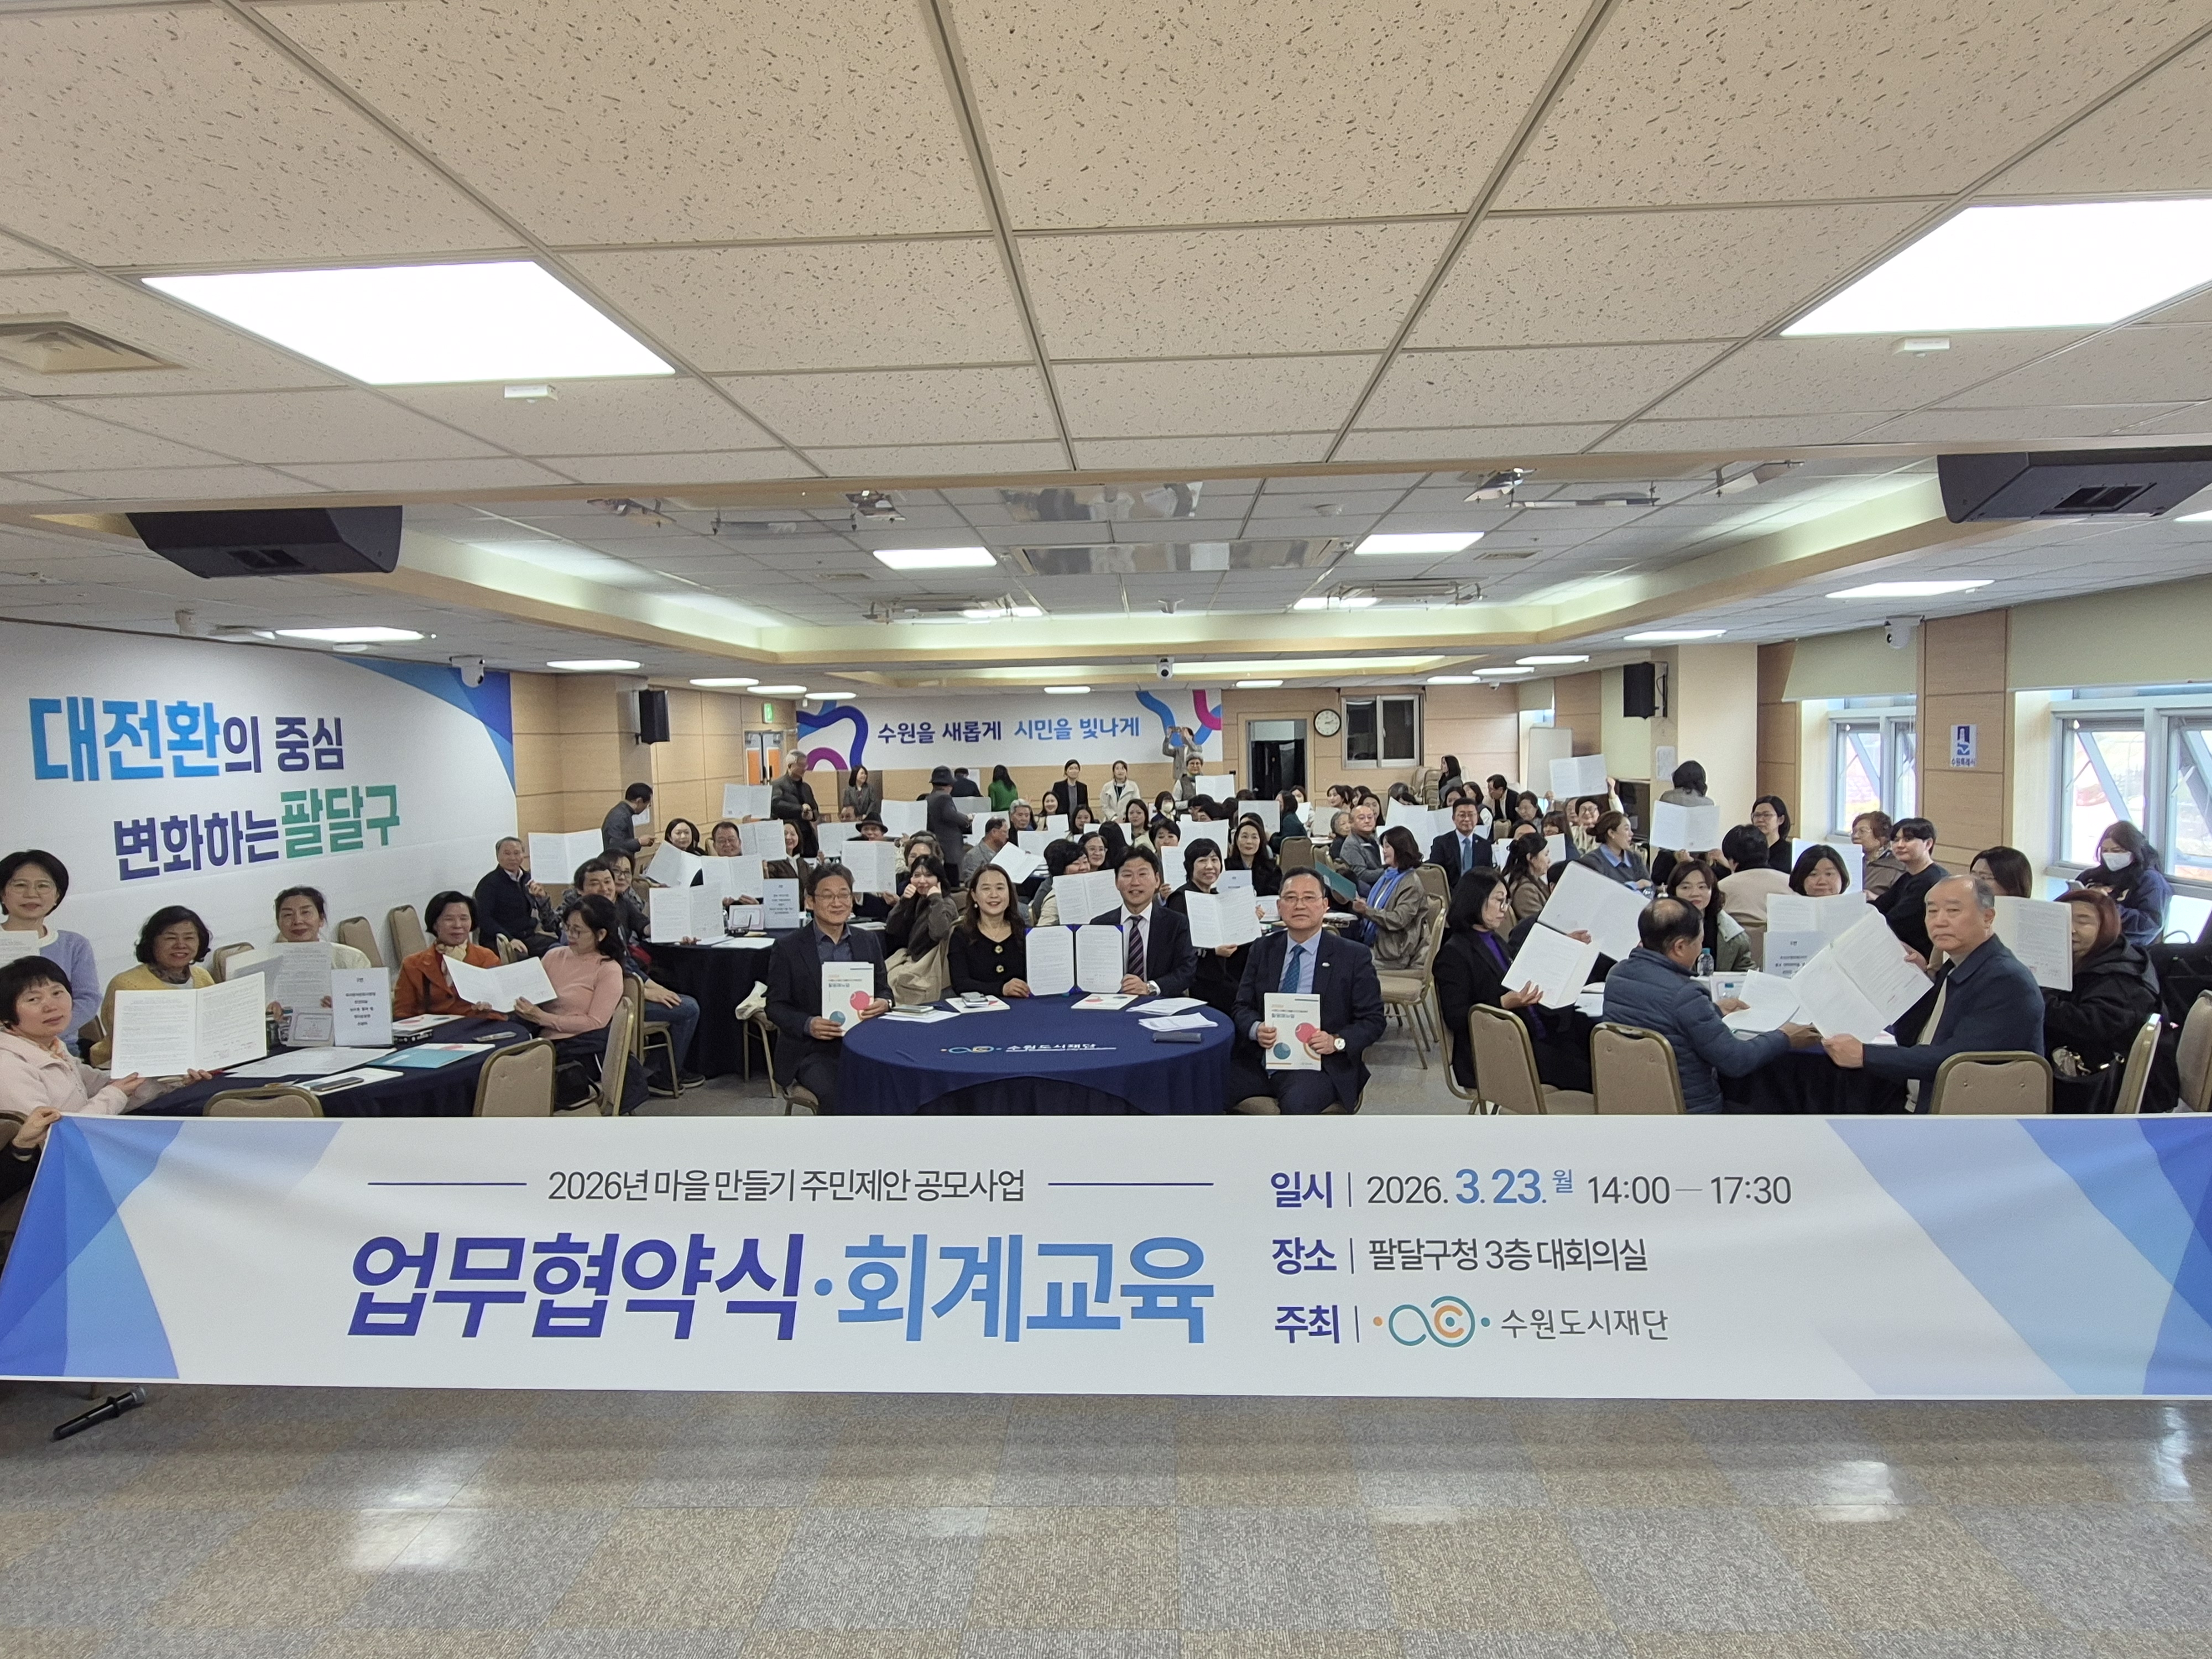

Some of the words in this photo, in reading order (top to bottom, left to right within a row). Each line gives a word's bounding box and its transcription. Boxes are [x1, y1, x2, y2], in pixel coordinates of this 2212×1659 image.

[29, 696, 262, 782] 대전환의
[275, 717, 344, 771] 중심
[877, 721, 936, 744] 수원을
[942, 721, 1002, 743] 새롭게
[1014, 718, 1072, 740] 시민을
[1079, 717, 1140, 739] 빛나게
[548, 1169, 648, 1201] 2026년
[654, 1169, 710, 1202] 마을
[715, 1168, 795, 1202] 만들기
[800, 1168, 911, 1202] 주민제안
[914, 1169, 1024, 1202] 공모사업
[1270, 1171, 1333, 1208] 일시
[1552, 1168, 1574, 1193] 월
[1272, 1237, 1337, 1275] 장소
[1369, 1238, 1478, 1271] 팔달구청
[1485, 1238, 1533, 1271] 3층
[1536, 1238, 1648, 1271] 대회의실
[1275, 1305, 1340, 1344] 주최
[1500, 1309, 1668, 1340] 수원도시재단
